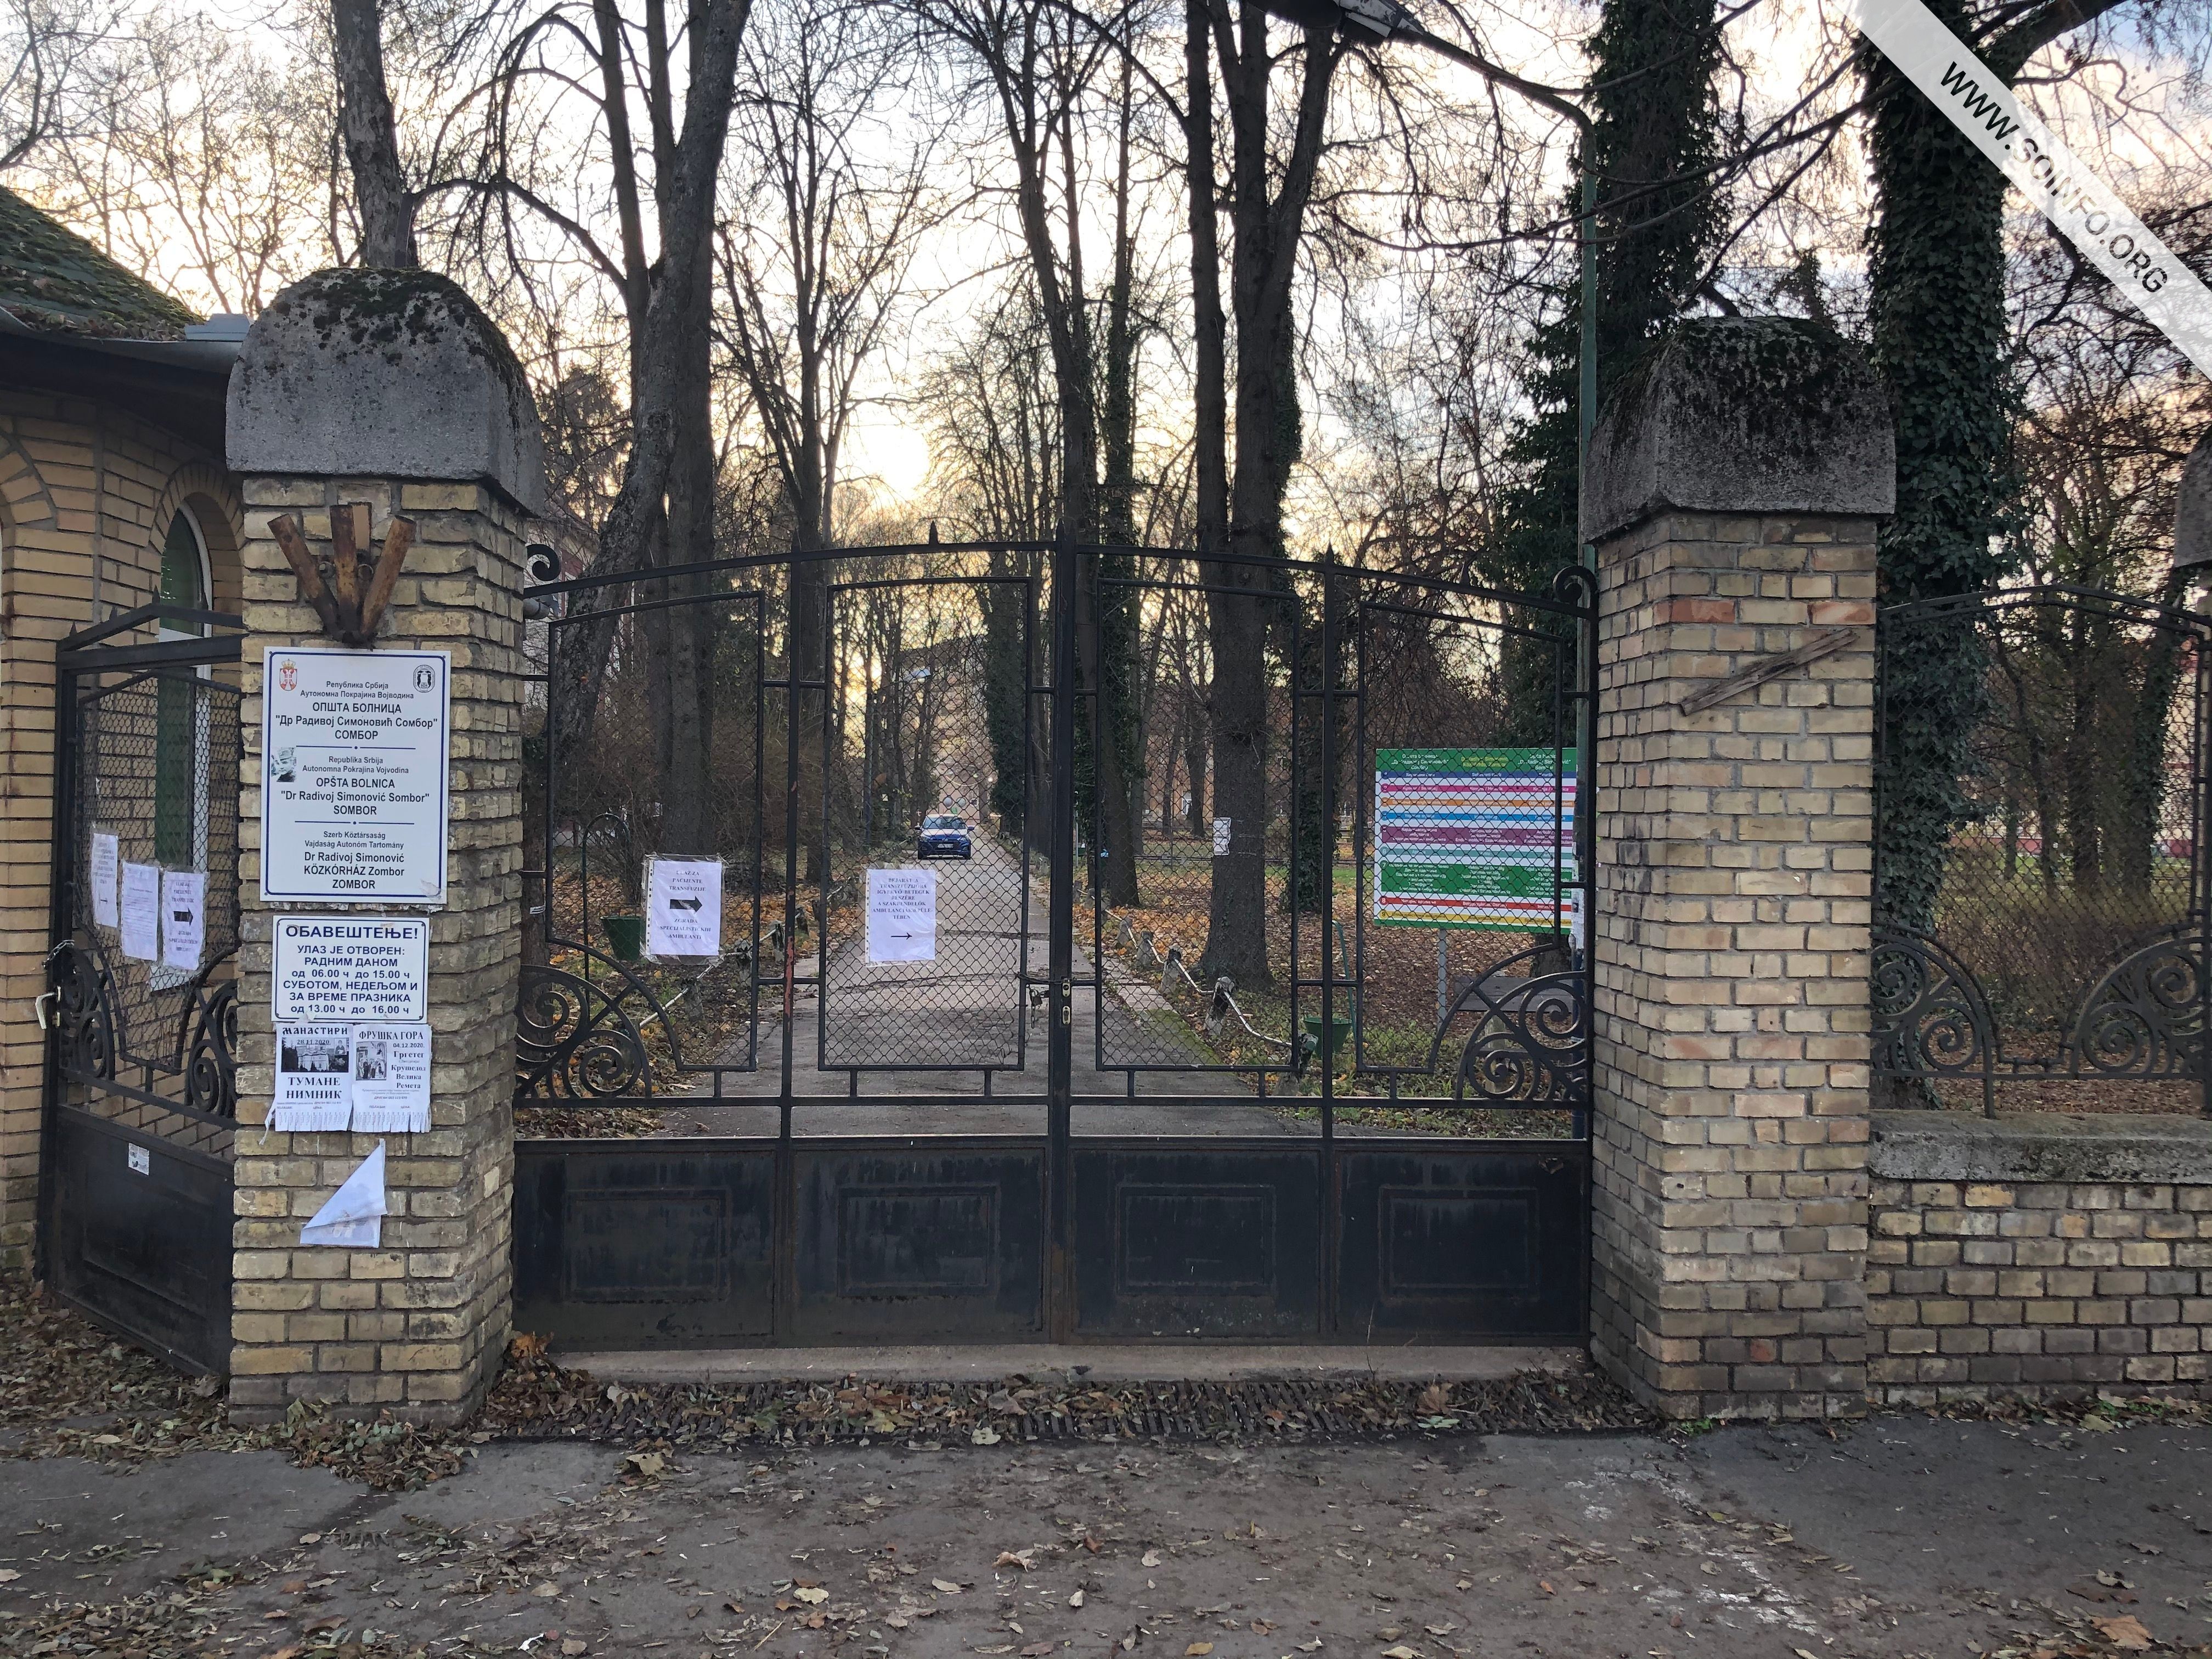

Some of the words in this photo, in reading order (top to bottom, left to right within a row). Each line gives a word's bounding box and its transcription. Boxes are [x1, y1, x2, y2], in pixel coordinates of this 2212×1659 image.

[313, 702, 349, 712] ОПШТА
[353, 703, 402, 714] БОЛНИЦА
[275, 715, 292, 726] "Др
[296, 716, 334, 727] Радивој
[337, 717, 392, 726] Симоновић
[396, 718, 438, 729] Сомбор"
[335, 730, 378, 740] СОМБОР
[343, 765, 374, 774] Pokrajina
[316, 776, 348, 787] OPŠTA
[352, 778, 395, 788] BOLNICA
[281, 791, 296, 800] "Dr
[300, 791, 334, 803] Radivoj
[337, 792, 386, 802] Simonović
[388, 793, 430, 802] Sombor"
[334, 805, 377, 815] SOMBOR
[345, 831, 386, 840] Köztársaság
[304, 840, 335, 849] Vajdaság
[369, 842, 404, 850] Tartomány
[304, 852, 315, 861] Dr
[318, 853, 353, 864] Radivoj
[356, 853, 404, 862] Simonović
[304, 864, 365, 875] KÖZKÓRHÁZ
[369, 866, 404, 876] Zombor
[332, 879, 375, 889] ZOMBOR
[286, 926, 418, 939] ОБАВЕШТЕЊЕ!
[297, 945, 326, 953] УЛАЗ
[330, 946, 343, 954] ЈЕ
[347, 946, 405, 955] ОТВОРЕН:
[304, 957, 352, 966] РАДНИМ
[356, 958, 398, 967] ДАНОМ
[292, 970, 305, 979] од
[312, 969, 339, 978] 06.00
[373, 970, 400, 979] 15.00
[283, 980, 342, 991] СУБОТОМ,
[346, 981, 407, 991] НЕДЕЉОМ
[289, 992, 304, 1001] ЗА
[308, 993, 347, 1001] ВРЕМЕ
[351, 994, 411, 1002] ПРАЗНИКА
[291, 1006, 304, 1014] од
[308, 1005, 335, 1013] 13.00
[373, 1006, 399, 1014] 16.00
[359, 1031, 398, 1040] ФРУШКА
[400, 1031, 423, 1040] ГОРА
[288, 1077, 341, 1086] ТУМАНЕ
[286, 1090, 342, 1099] НИМНИК
